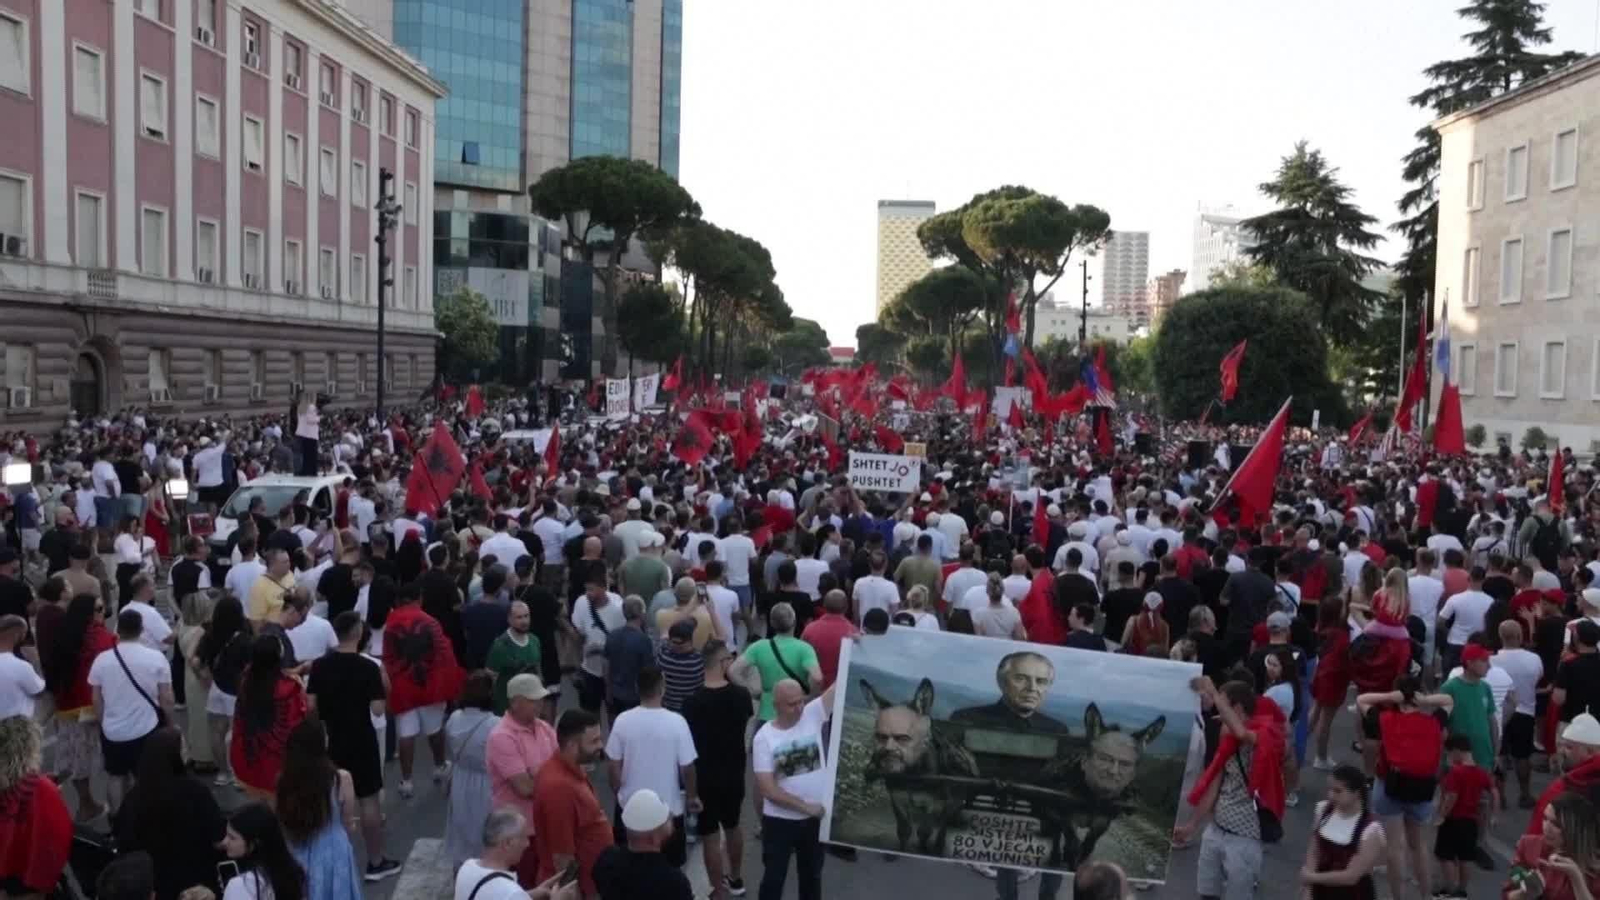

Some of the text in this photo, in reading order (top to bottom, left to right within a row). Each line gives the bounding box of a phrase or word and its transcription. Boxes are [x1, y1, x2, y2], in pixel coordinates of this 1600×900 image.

[853, 459, 888, 471] SHTET
[889, 461, 909, 476] JO
[852, 475, 902, 488] PUSHTET
[953, 834, 975, 848] 80
[970, 825, 1033, 843] SISTEMI
[952, 846, 1042, 867] KOMUNIST
